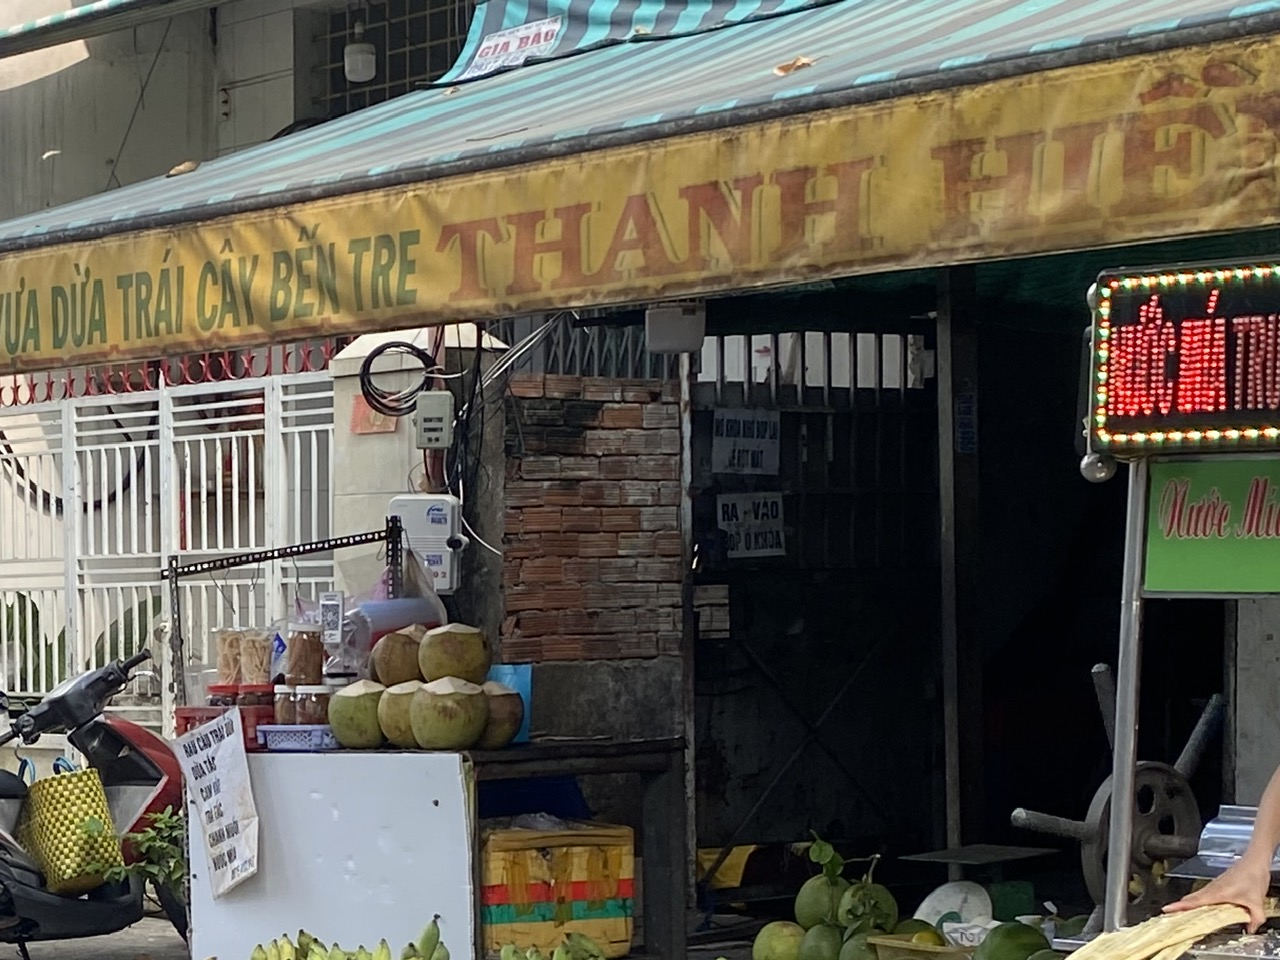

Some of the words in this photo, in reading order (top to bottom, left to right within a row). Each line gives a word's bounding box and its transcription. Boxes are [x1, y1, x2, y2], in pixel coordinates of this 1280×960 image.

[478, 41, 510, 59] GIA
[52, 262, 106, 349] DỪA
[116, 247, 184, 341] TRÁI
[196, 238, 260, 333] CÂY
[272, 223, 339, 321] BẾN
[346, 228, 421, 312] TRE
[436, 157, 886, 302] THANH
[722, 502, 739, 522] RA
[1234, 475, 1280, 540] Mí
